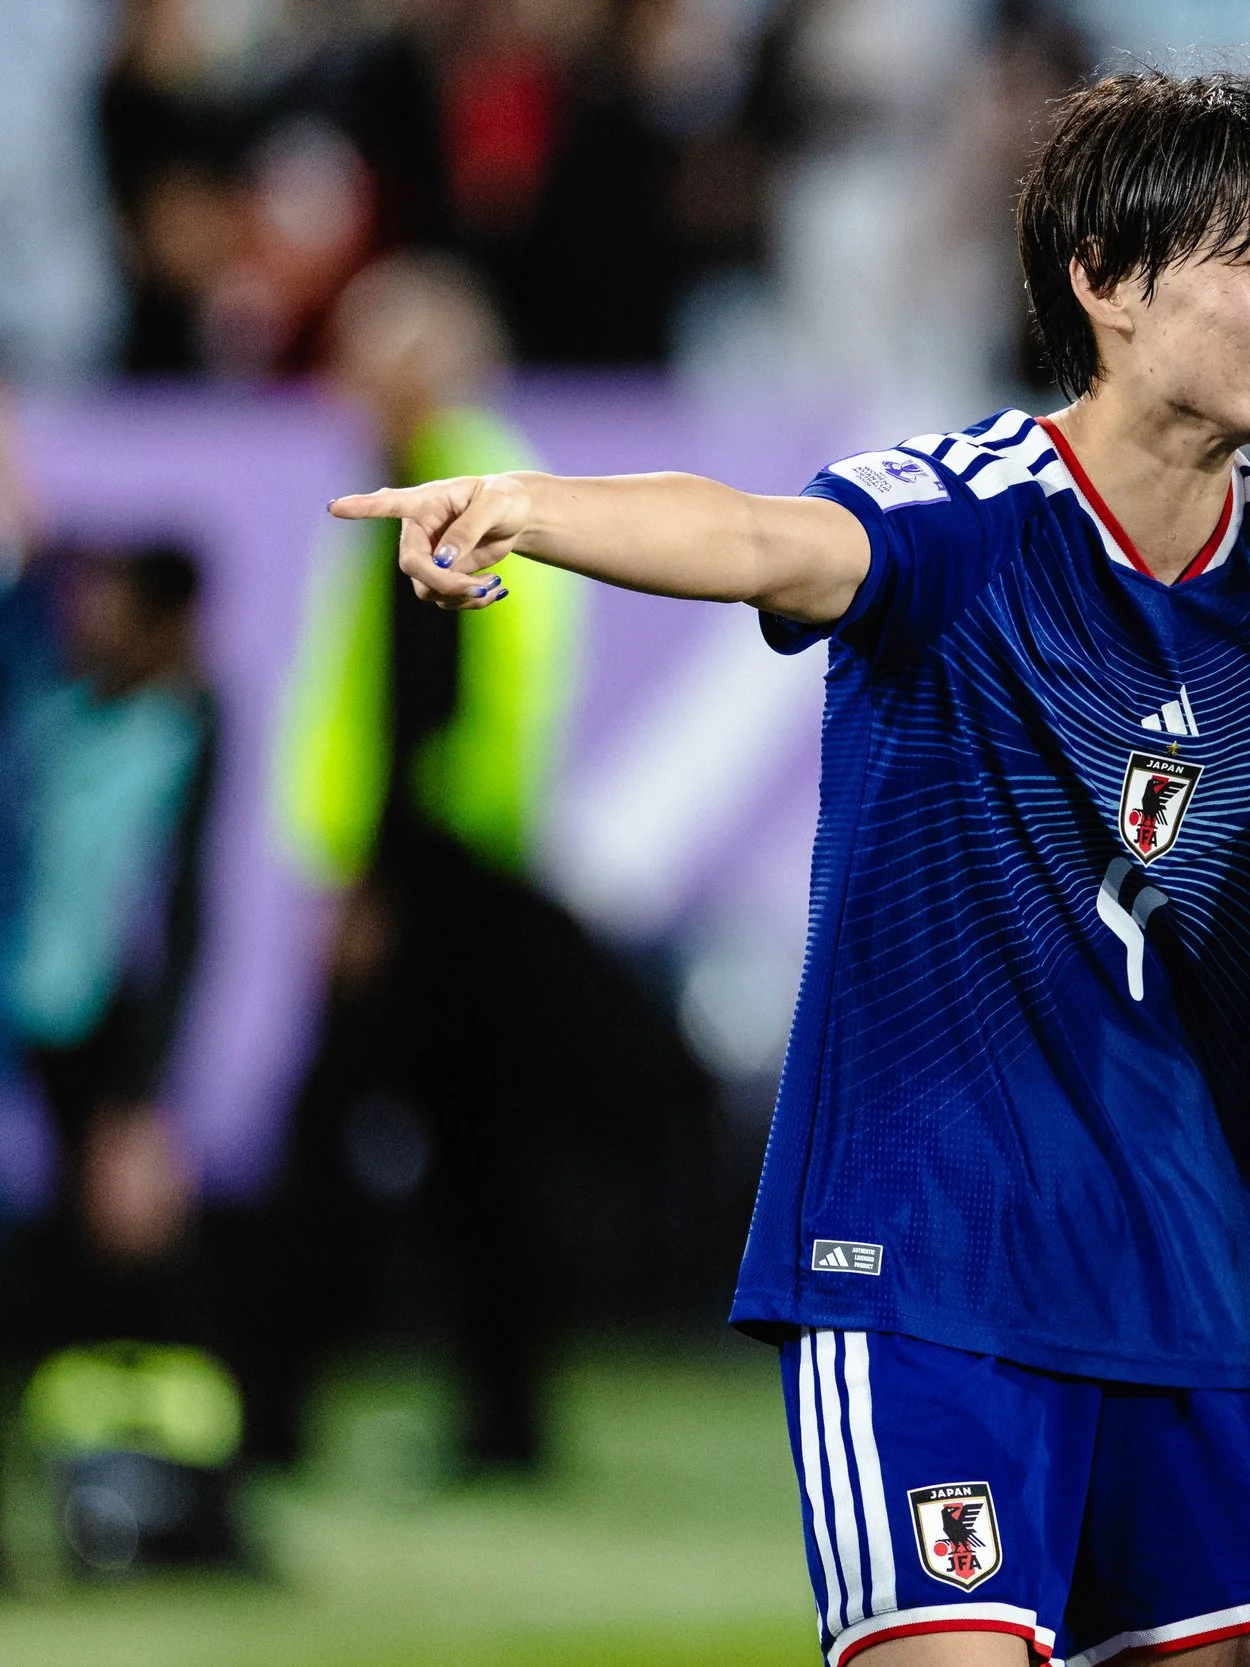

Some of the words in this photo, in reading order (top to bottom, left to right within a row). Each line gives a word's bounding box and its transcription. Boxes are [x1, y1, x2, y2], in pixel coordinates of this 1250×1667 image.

[1146, 759, 1184, 774] JAPAN
[1133, 828, 1158, 847] JFA
[930, 1486, 972, 1499] JAPAN
[946, 1555, 982, 1572] JFA
